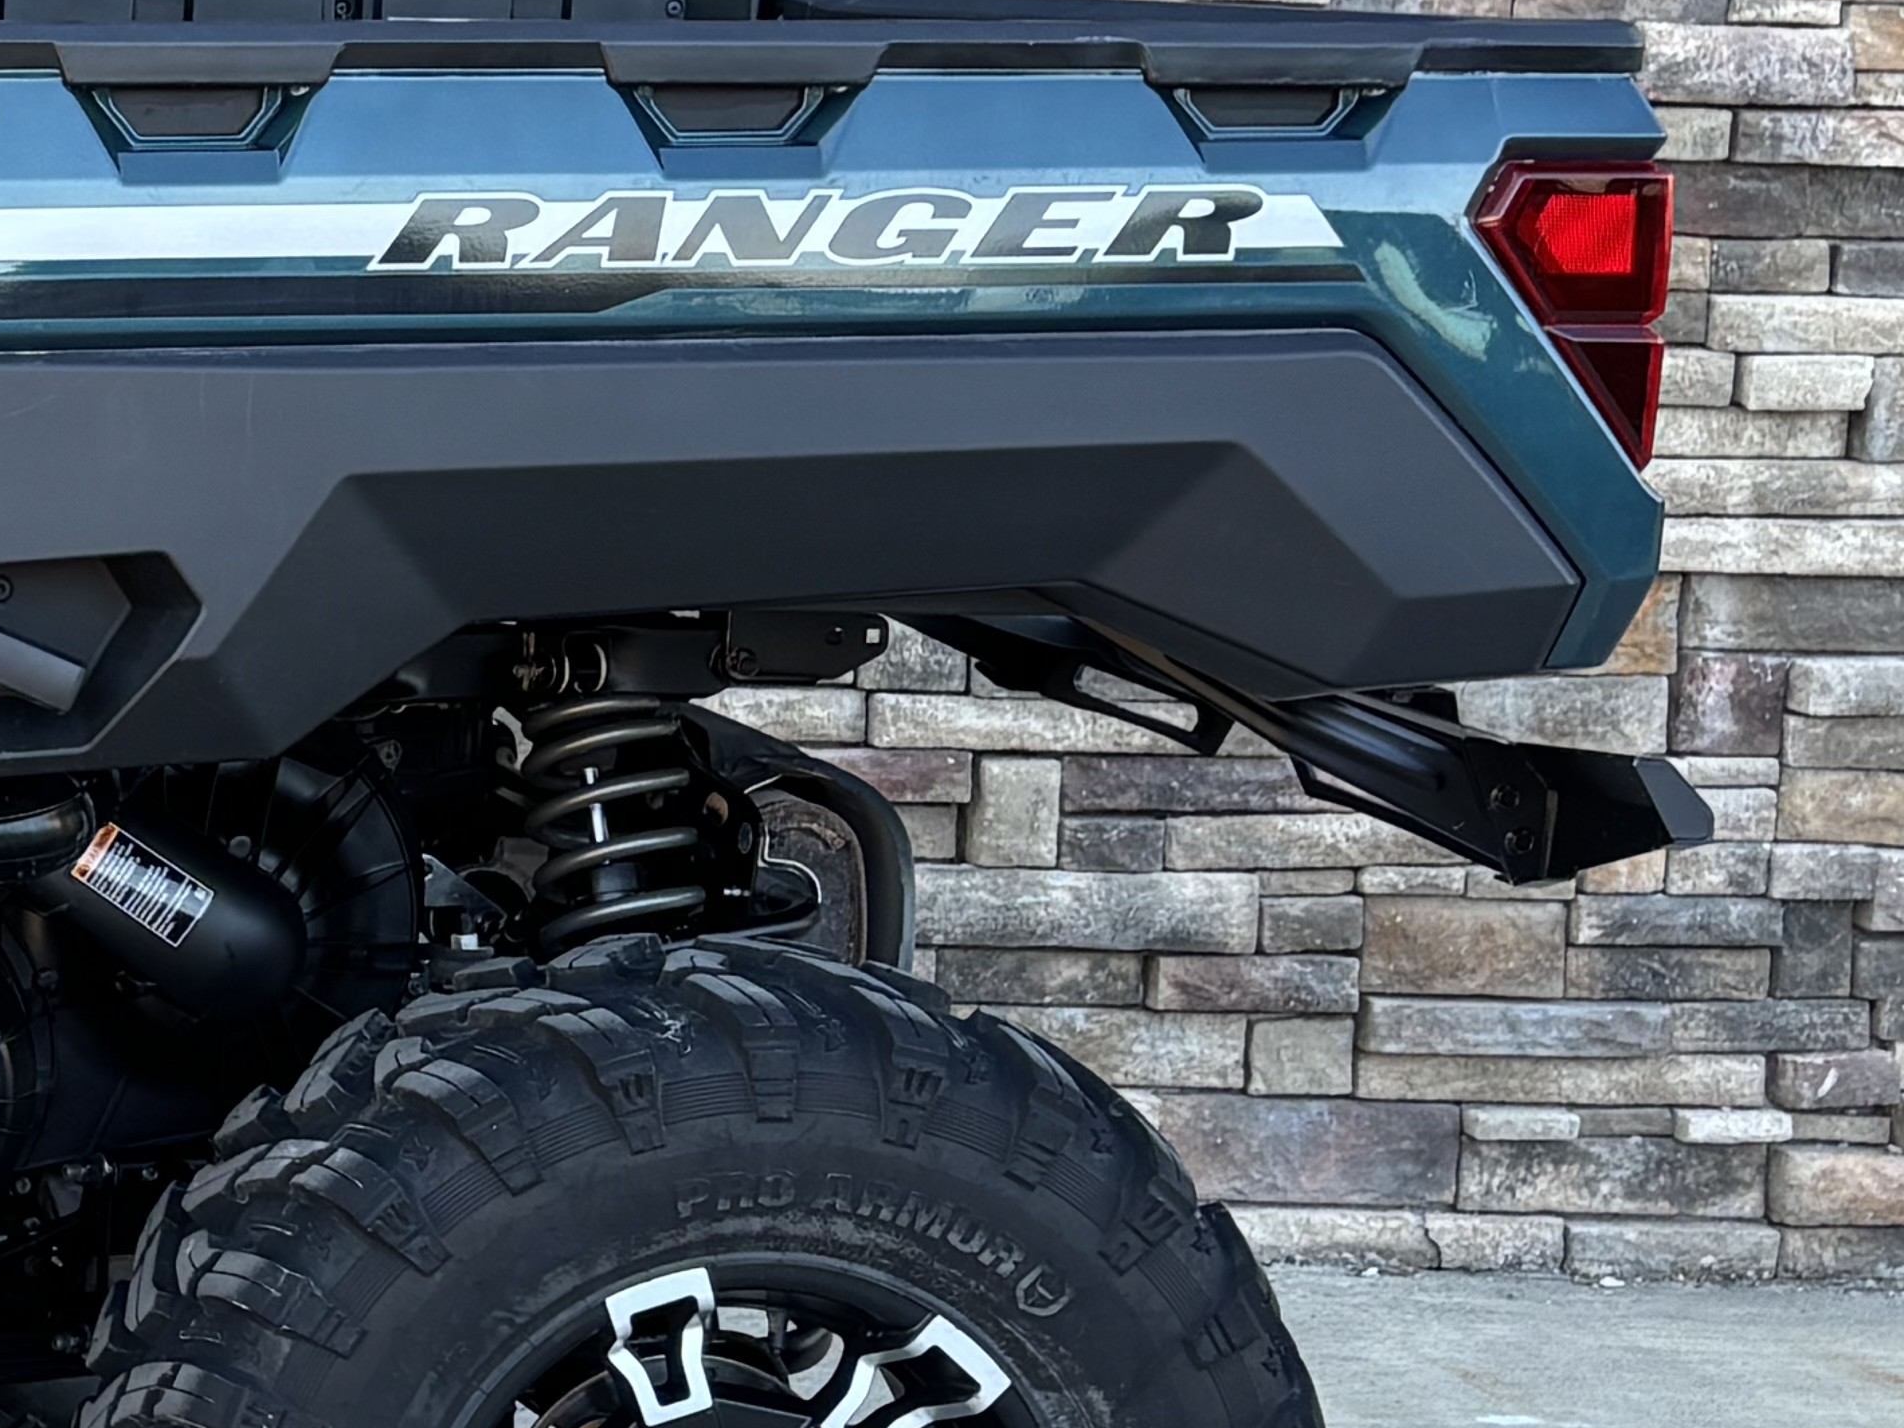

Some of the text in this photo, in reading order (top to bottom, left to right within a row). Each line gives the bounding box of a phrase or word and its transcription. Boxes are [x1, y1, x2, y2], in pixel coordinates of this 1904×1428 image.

[371, 186, 1266, 269] RANGER
[675, 1172, 1027, 1277] PRO ARMOR
